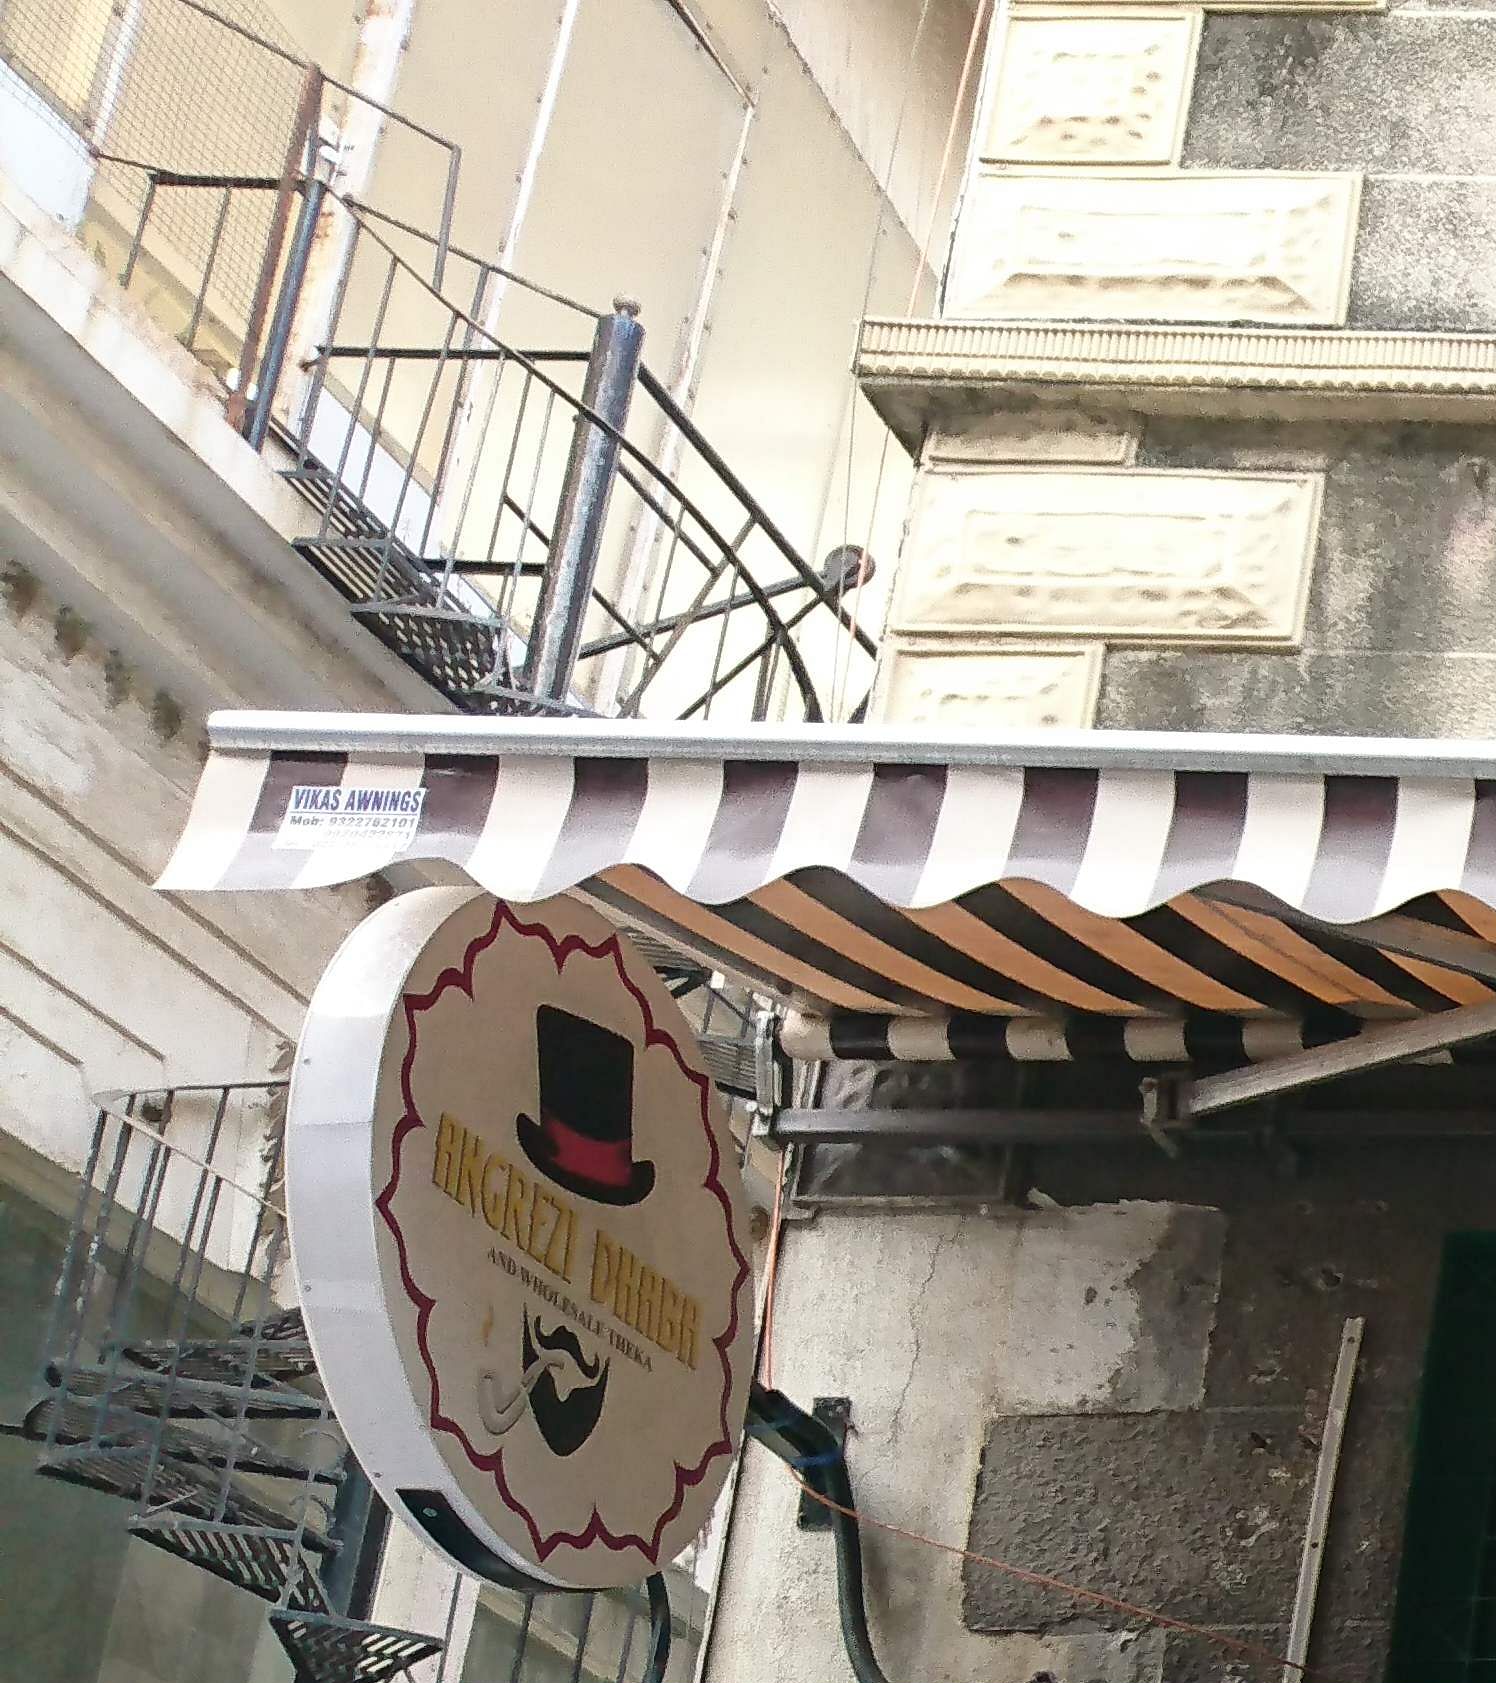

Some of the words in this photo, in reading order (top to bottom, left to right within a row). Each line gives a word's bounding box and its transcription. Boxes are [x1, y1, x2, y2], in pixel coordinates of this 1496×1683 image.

[294, 788, 342, 811] VIKAS
[344, 789, 420, 813] AWNINGS
[432, 1112, 574, 1284] ANGREZI
[591, 1228, 701, 1371] DHABA
[487, 1247, 517, 1276] AND
